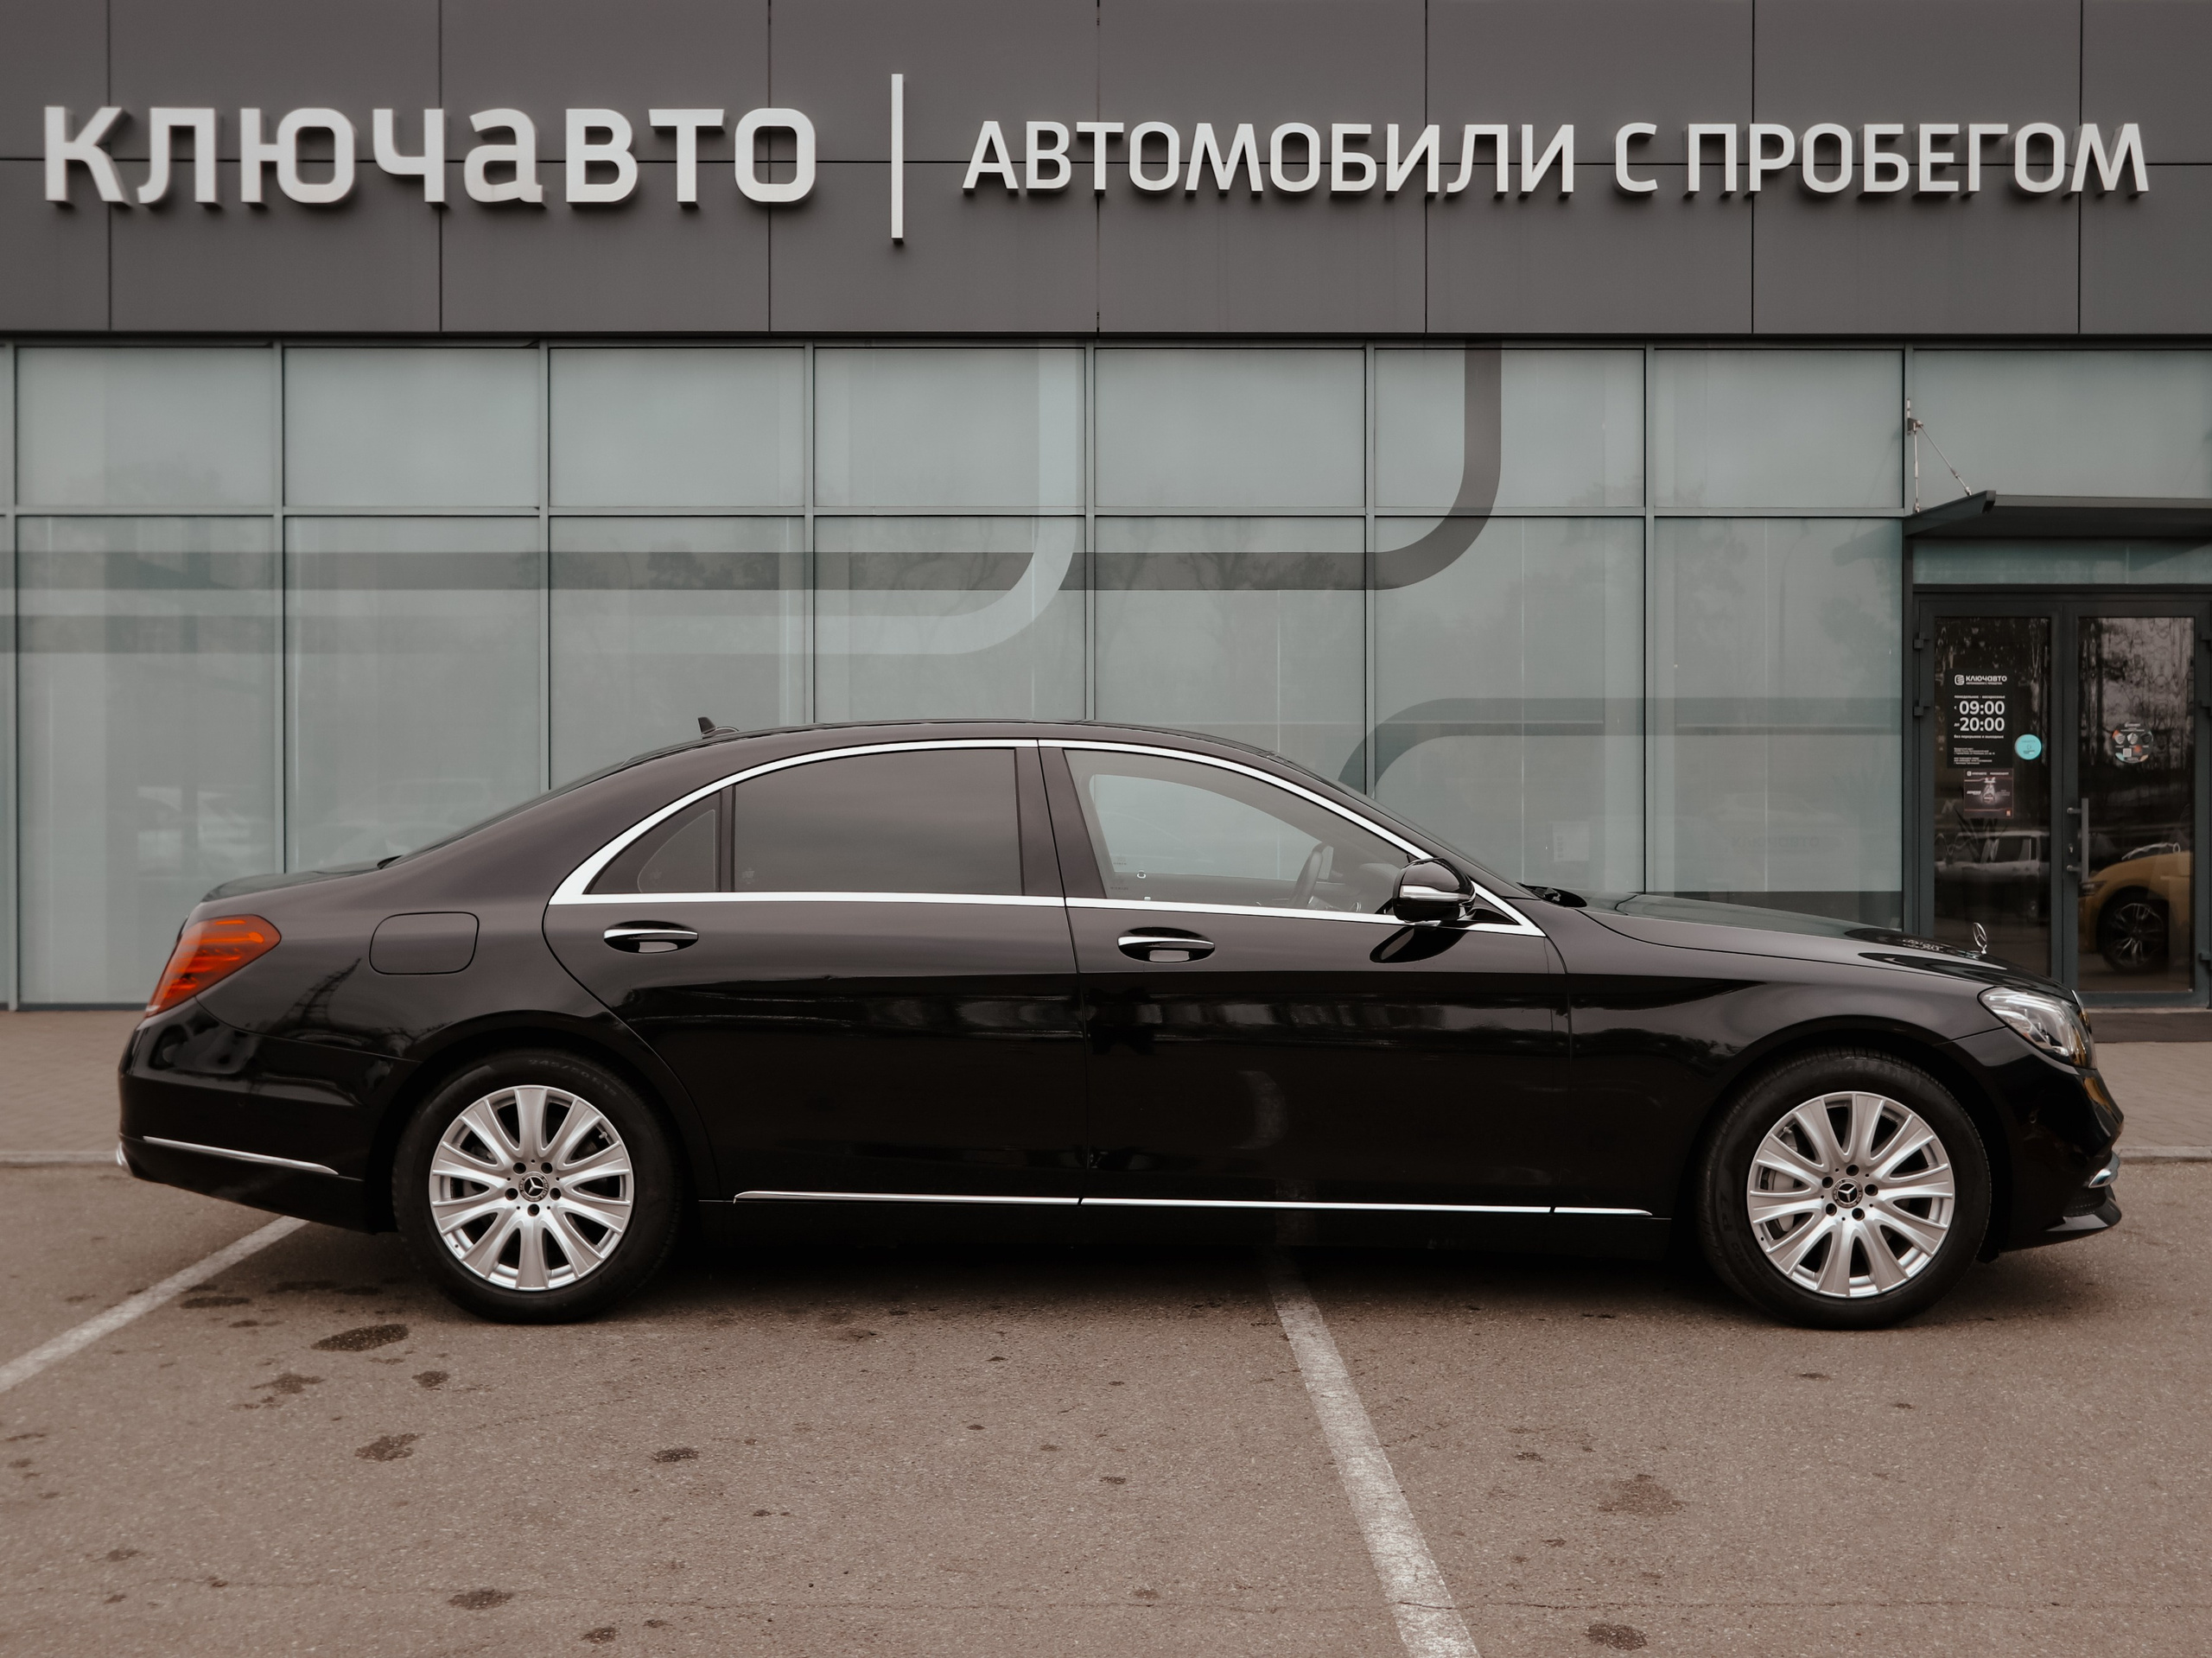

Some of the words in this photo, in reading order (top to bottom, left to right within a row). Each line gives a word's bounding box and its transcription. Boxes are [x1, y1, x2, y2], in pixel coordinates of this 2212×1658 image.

[962, 120, 1576, 194] АВТОМОБИЛИ
[1614, 121, 1658, 194] С
[1688, 122, 2151, 194] ПРОБЕГОМ
[1959, 700, 2005, 715] 09:00
[1960, 716, 2005, 732] 20:00
